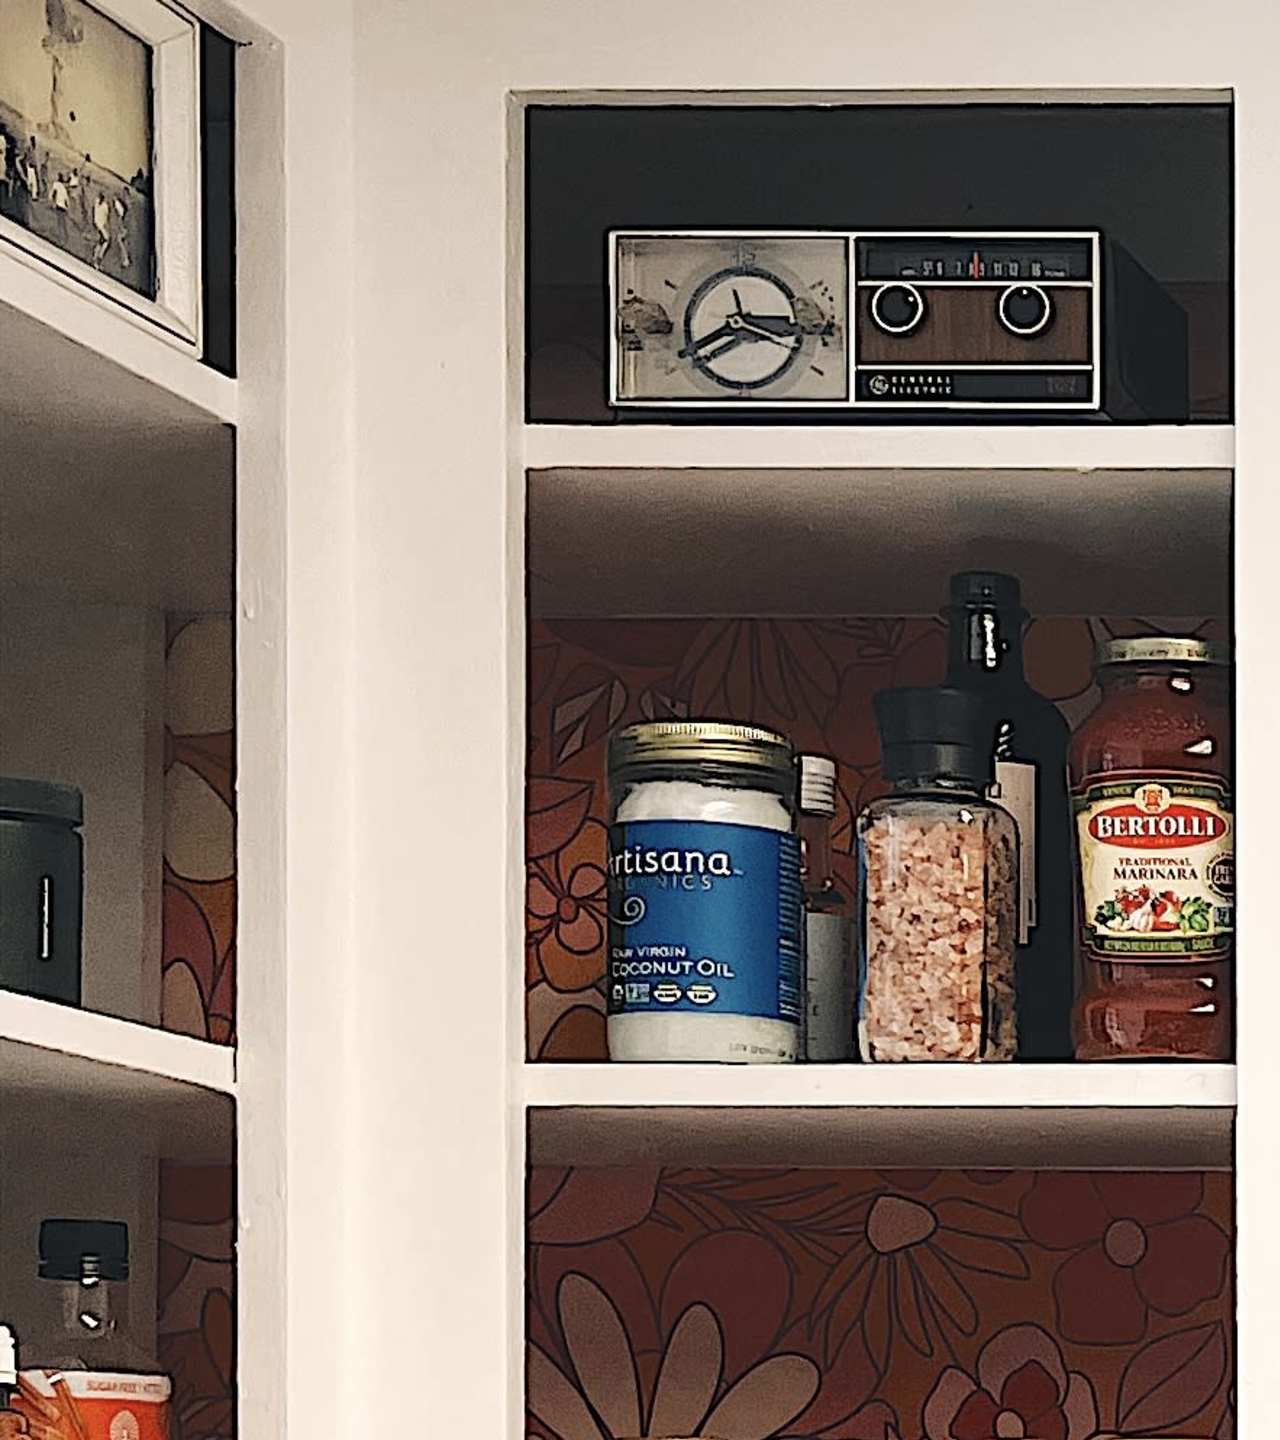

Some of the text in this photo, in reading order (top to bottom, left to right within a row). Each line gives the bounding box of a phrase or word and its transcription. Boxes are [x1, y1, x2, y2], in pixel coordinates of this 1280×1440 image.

[1097, 815, 1216, 838] BERTOLLI
[1118, 857, 1193, 867] TRADITIONAL
[1113, 868, 1199, 881] MARINARA
[637, 946, 686, 958] VIRGIN
[612, 959, 735, 978] COCONUT OIL
